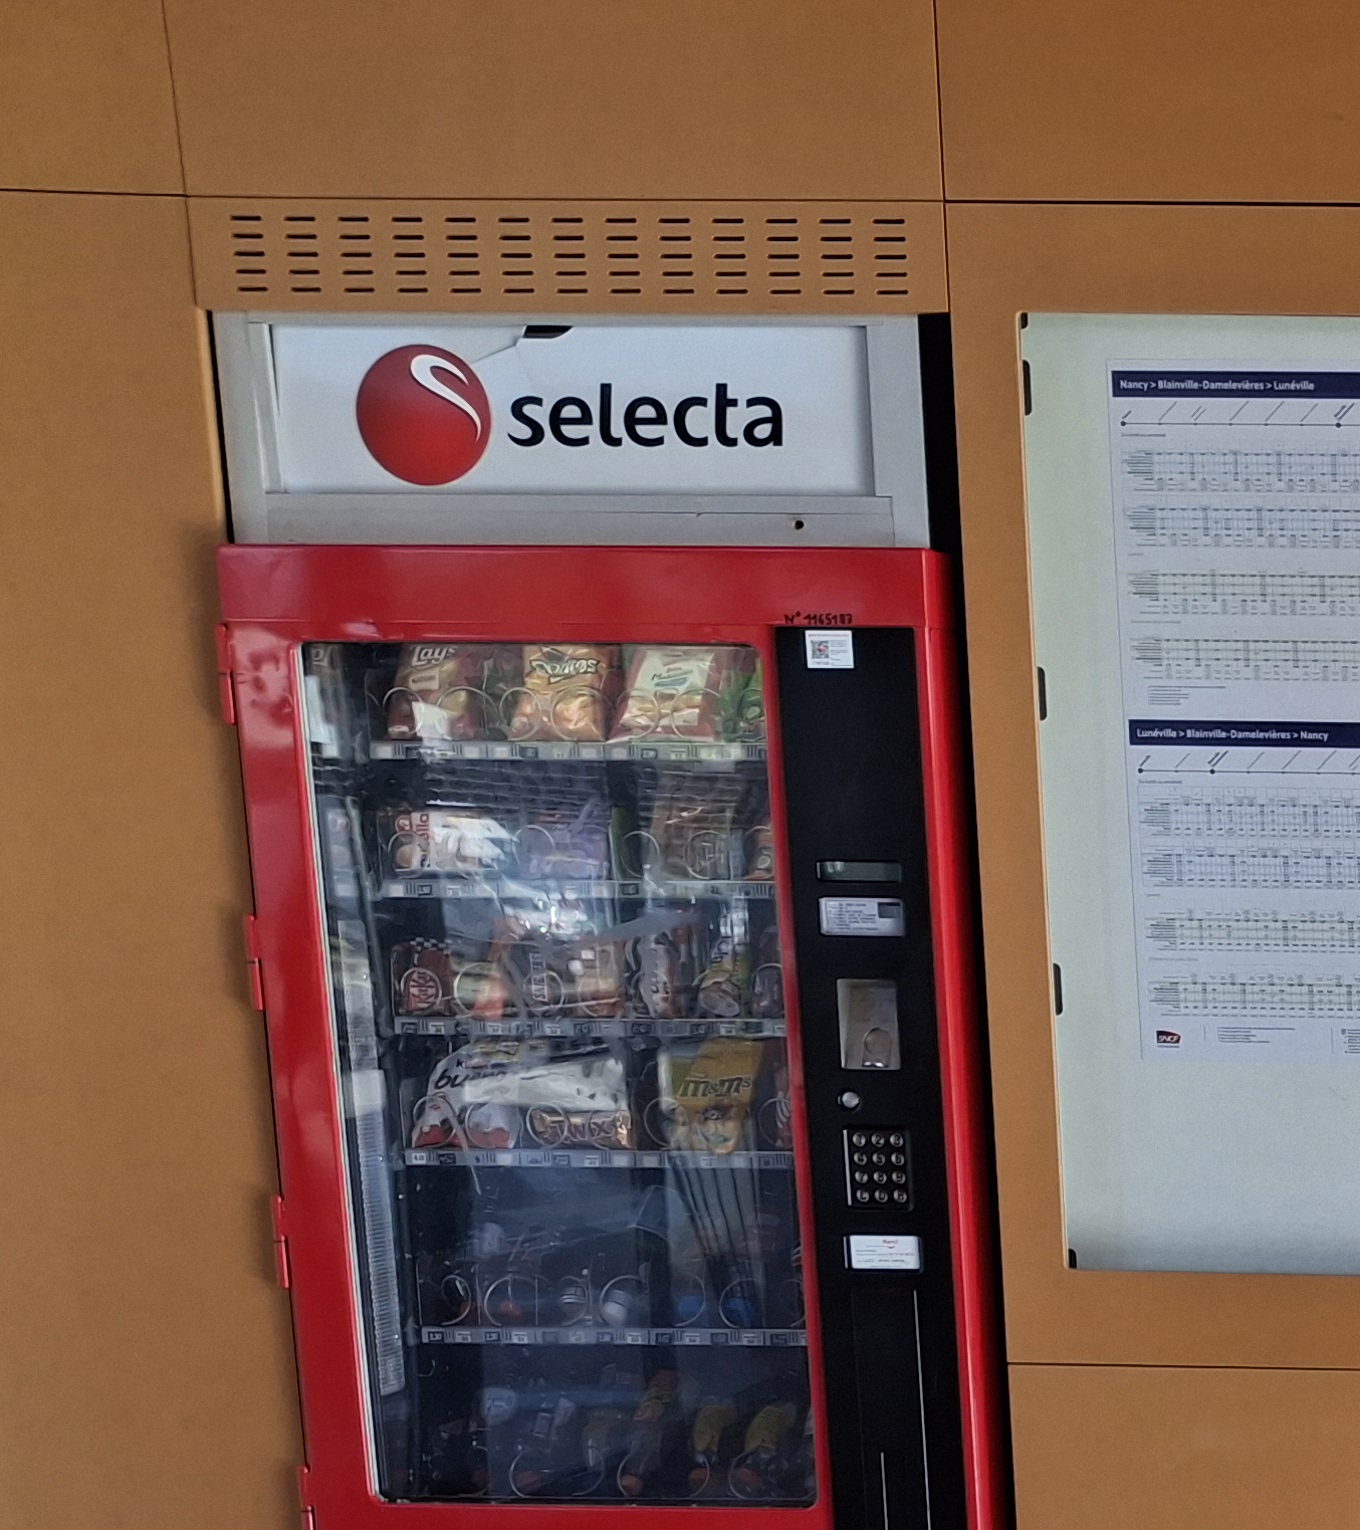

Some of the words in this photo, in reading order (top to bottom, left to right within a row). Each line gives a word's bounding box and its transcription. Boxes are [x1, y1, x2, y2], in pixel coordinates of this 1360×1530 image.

[1119, 380, 1148, 390] Nancy
[1158, 380, 1264, 390] Blainville-Damelevières
[1273, 381, 1314, 390] Lunéville
[508, 383, 783, 448] selecta
[1137, 729, 1177, 738] Lunéville
[1187, 730, 1291, 739] Blainville-Damelevières
[1301, 732, 1329, 742] Nancy
